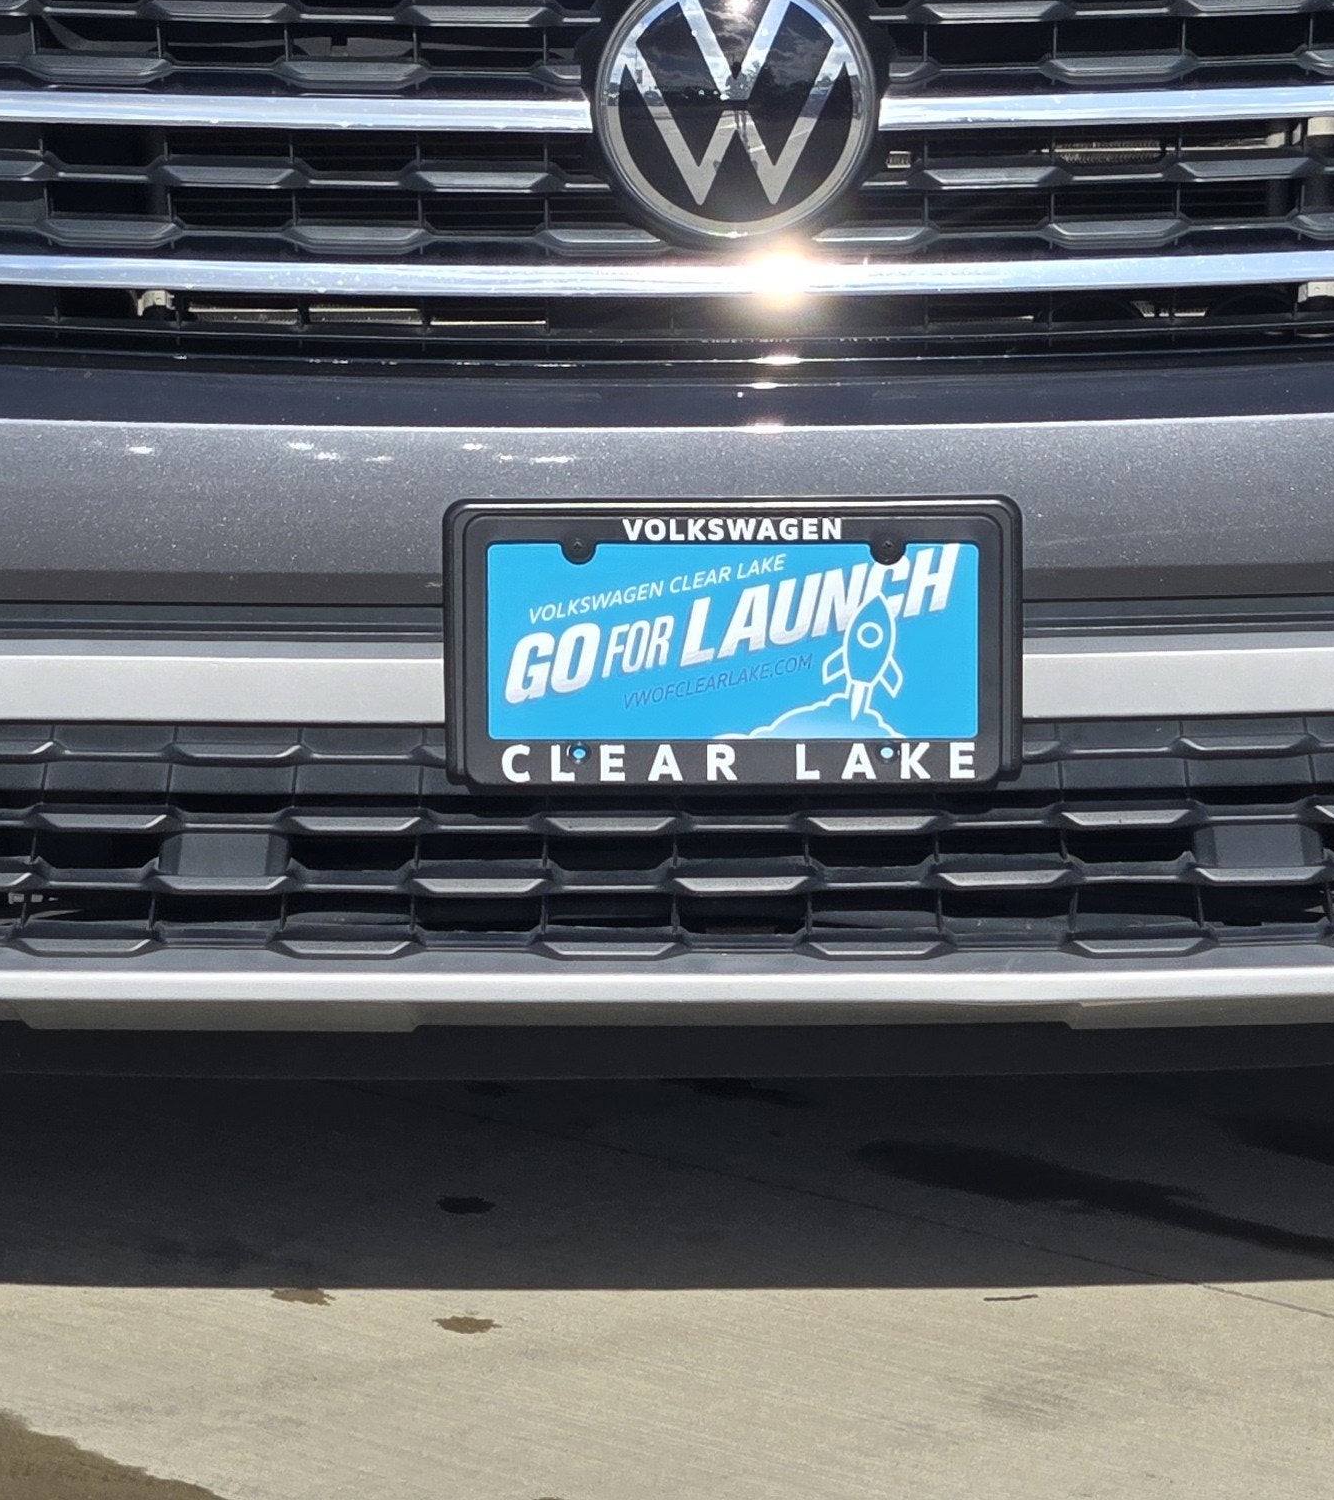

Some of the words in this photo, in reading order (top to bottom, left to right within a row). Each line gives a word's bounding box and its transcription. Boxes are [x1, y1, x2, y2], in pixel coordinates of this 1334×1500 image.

[621, 518, 842, 541] VOLKSWAGEN
[528, 580, 665, 624] VOLKSWAGEN
[669, 566, 732, 593] CLEAR
[736, 553, 786, 581] LAKE
[504, 622, 601, 704] GO
[601, 615, 675, 678] FOR
[679, 542, 961, 667] LAUNCH
[623, 652, 813, 709] VWOFCLEARLAKE.COM
[501, 743, 738, 783] CLEAR
[795, 742, 976, 781] LAKE
